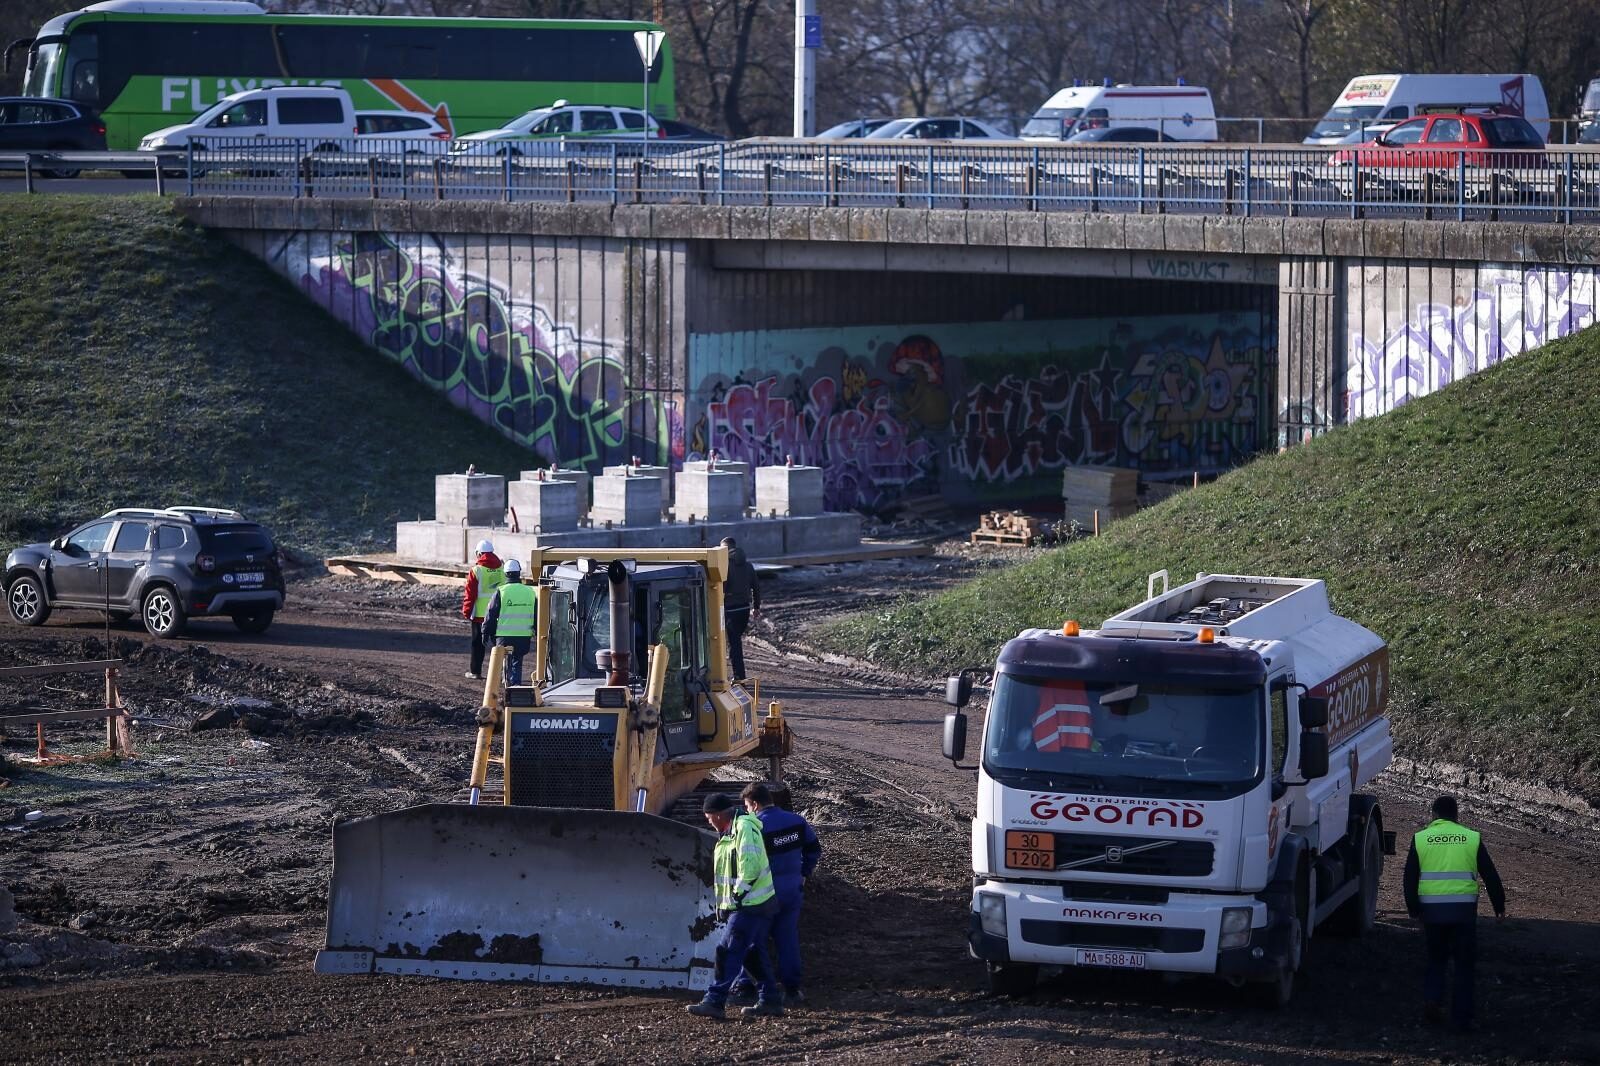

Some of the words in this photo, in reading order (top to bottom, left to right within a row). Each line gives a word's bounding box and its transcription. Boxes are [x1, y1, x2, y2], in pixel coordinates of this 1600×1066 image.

[1147, 259, 1230, 279] VIADUKT
[530, 717, 600, 730] KOMATSU
[1021, 833, 1039, 848] 30
[1011, 851, 1050, 867] 1202
